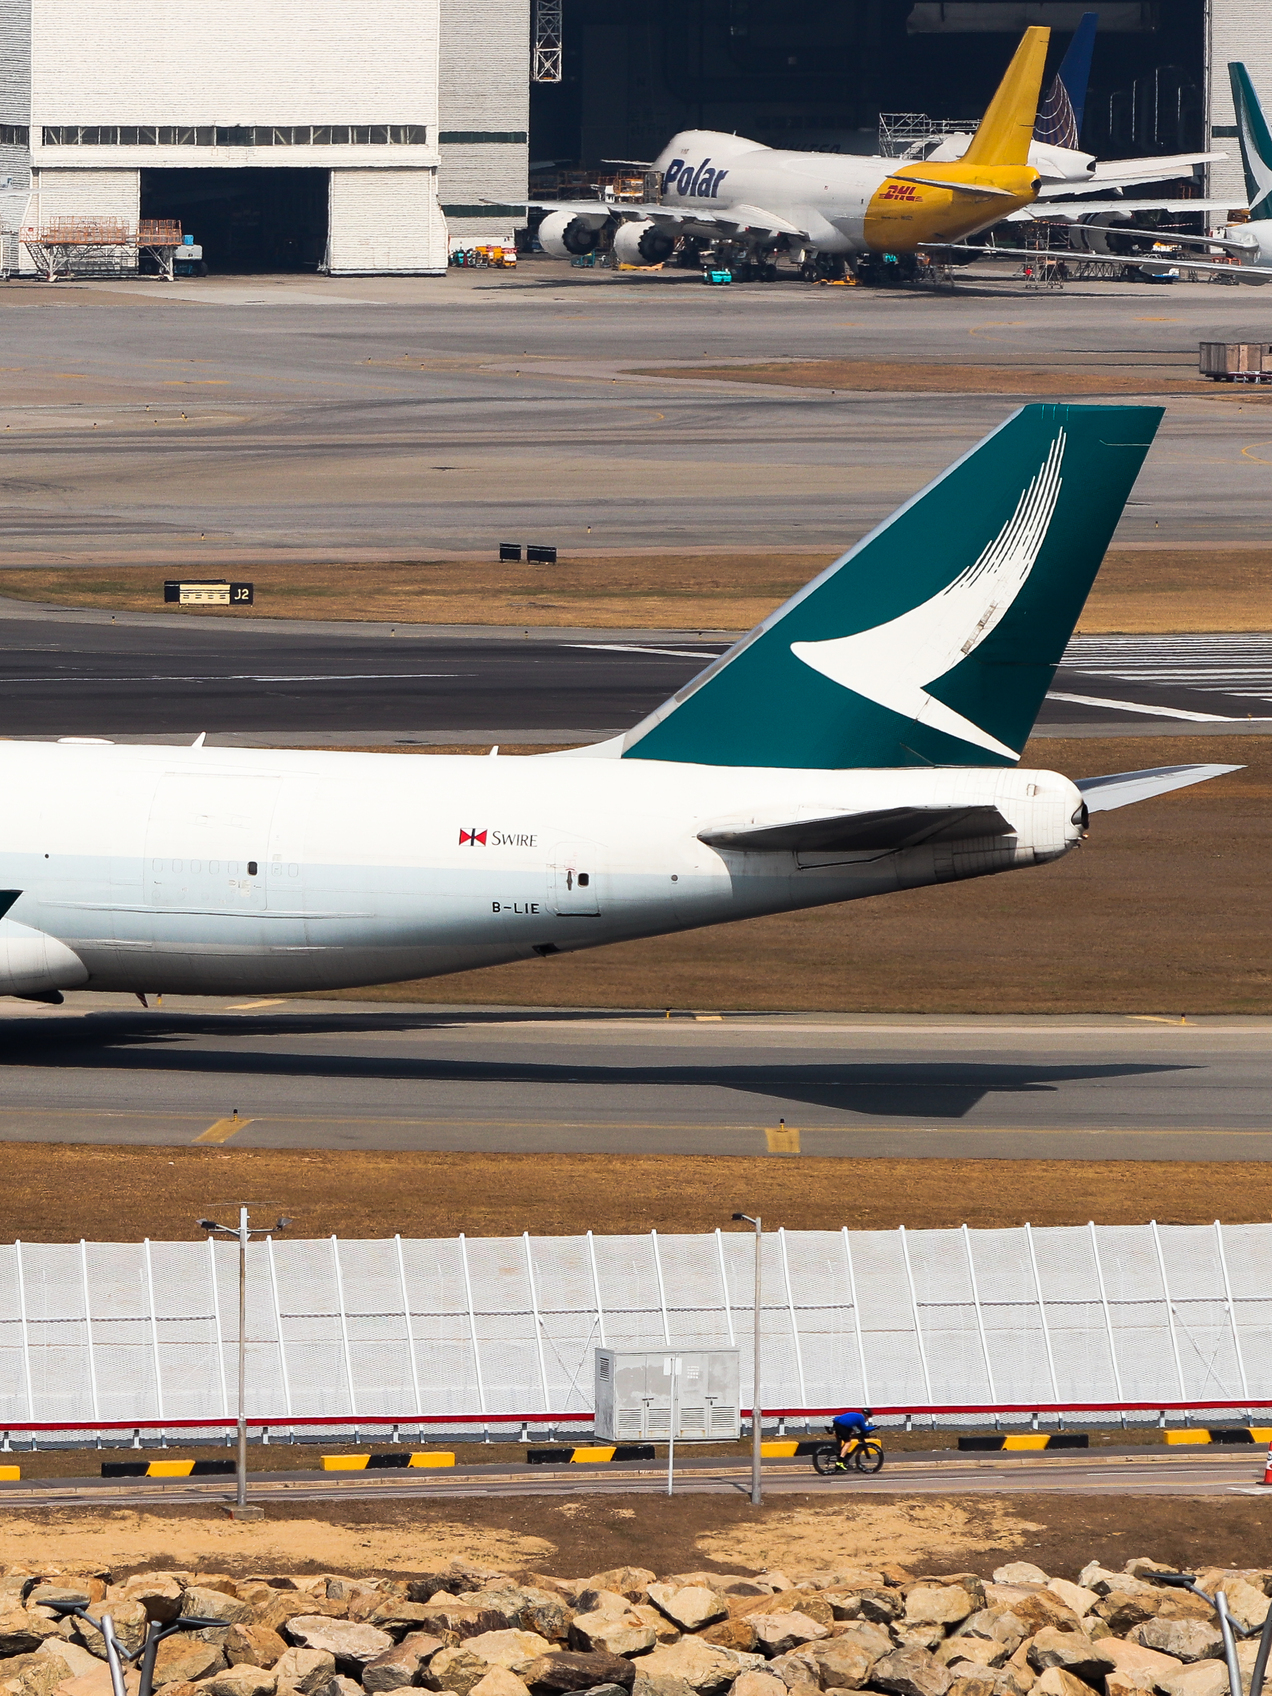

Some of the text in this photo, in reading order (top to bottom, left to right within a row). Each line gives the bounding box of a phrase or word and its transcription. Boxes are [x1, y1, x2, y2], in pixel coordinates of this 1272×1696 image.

[663, 157, 729, 199] Polar
[881, 184, 918, 202] DHL
[234, 588, 249, 600] J2
[491, 830, 538, 848] SWIRE
[492, 901, 540, 914] B-LIE
